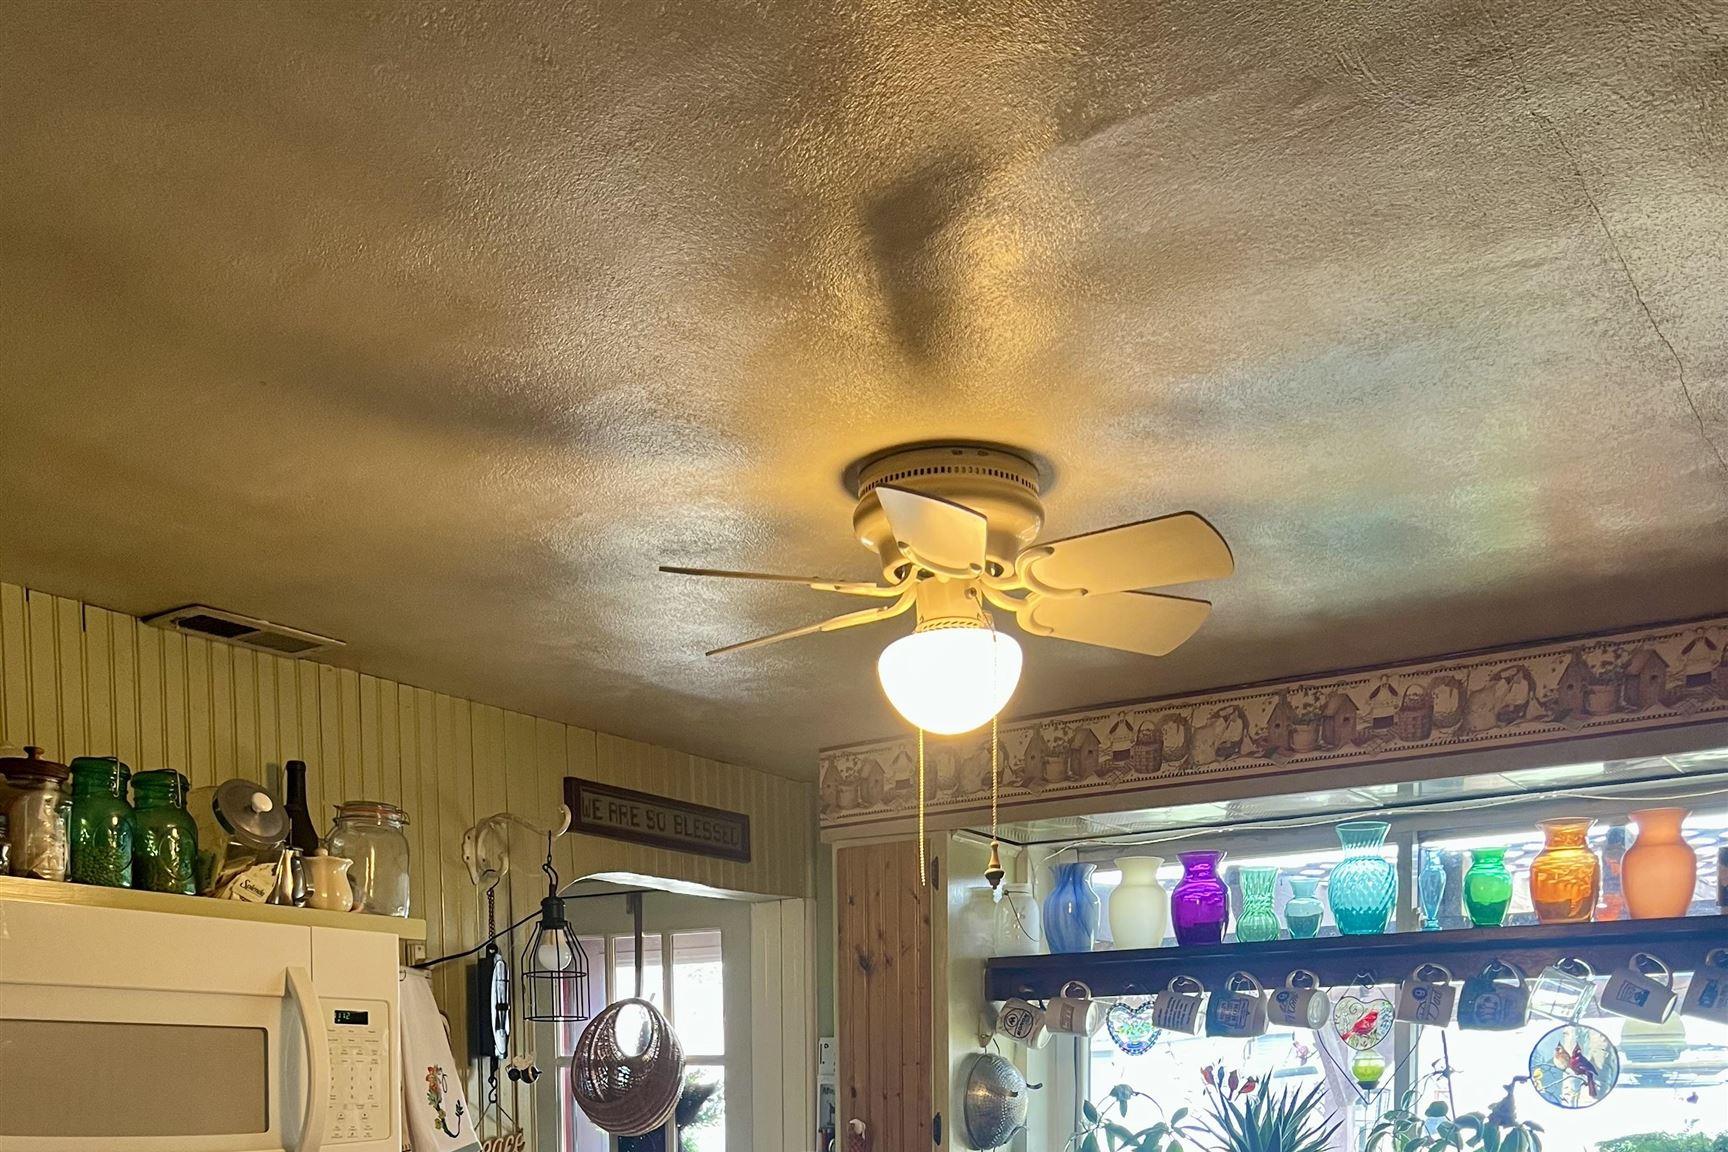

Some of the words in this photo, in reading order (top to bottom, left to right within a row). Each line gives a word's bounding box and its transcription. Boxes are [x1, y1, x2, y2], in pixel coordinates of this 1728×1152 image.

[581, 799, 603, 821] WE
[608, 802, 640, 828] ARE
[673, 814, 741, 847] BLESSED
